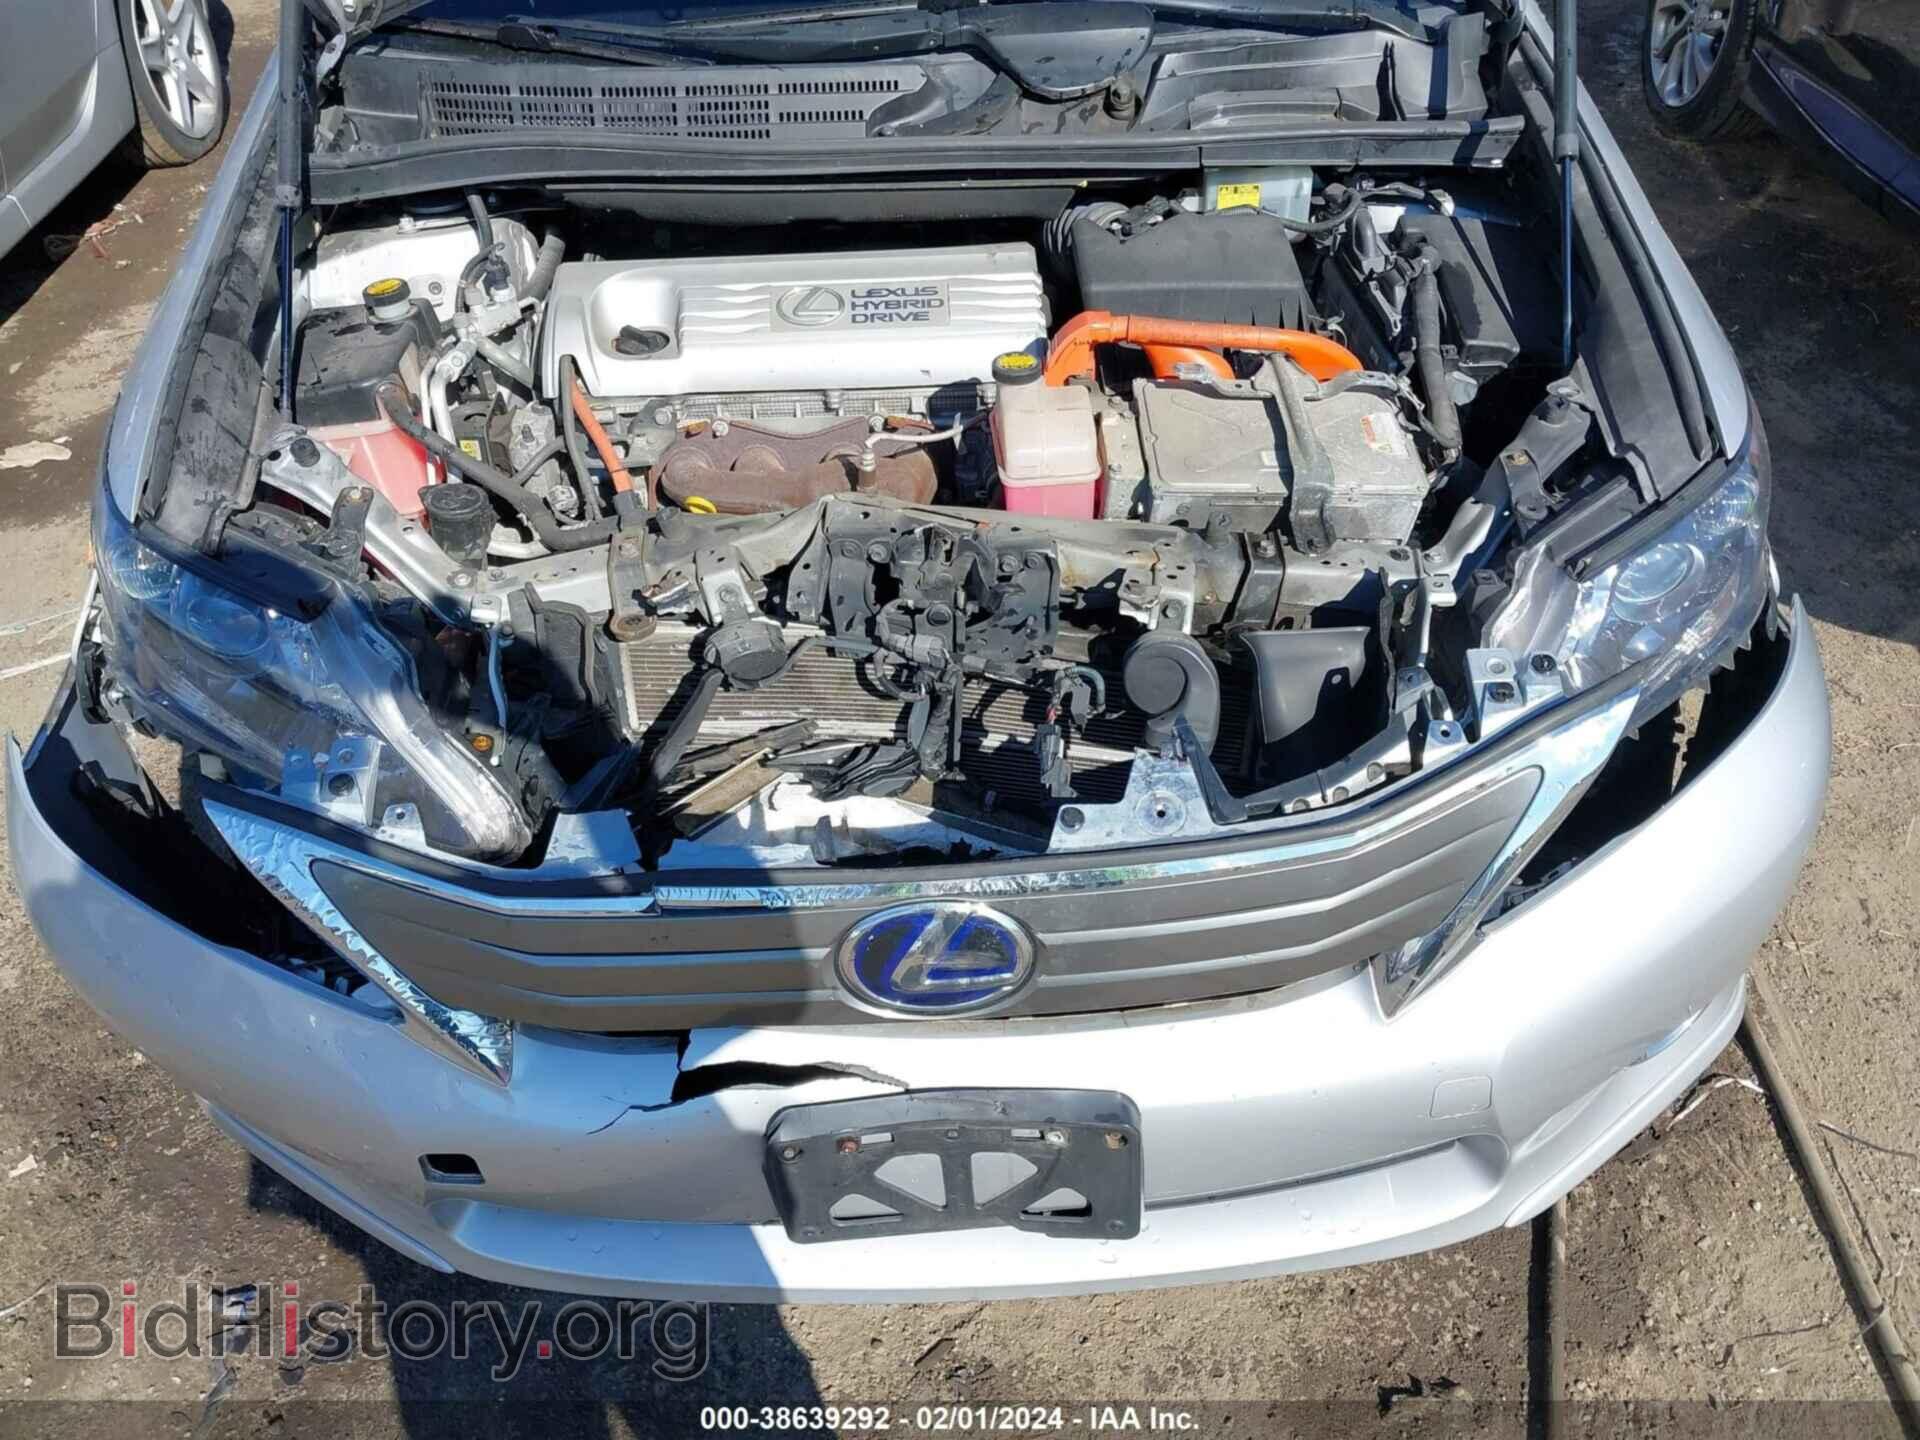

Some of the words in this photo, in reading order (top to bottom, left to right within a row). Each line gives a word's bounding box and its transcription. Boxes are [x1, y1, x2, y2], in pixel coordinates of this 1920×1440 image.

[851, 286, 939, 299] LEXUS
[851, 298, 945, 311] HYBRID
[851, 311, 930, 324] DRIVE
